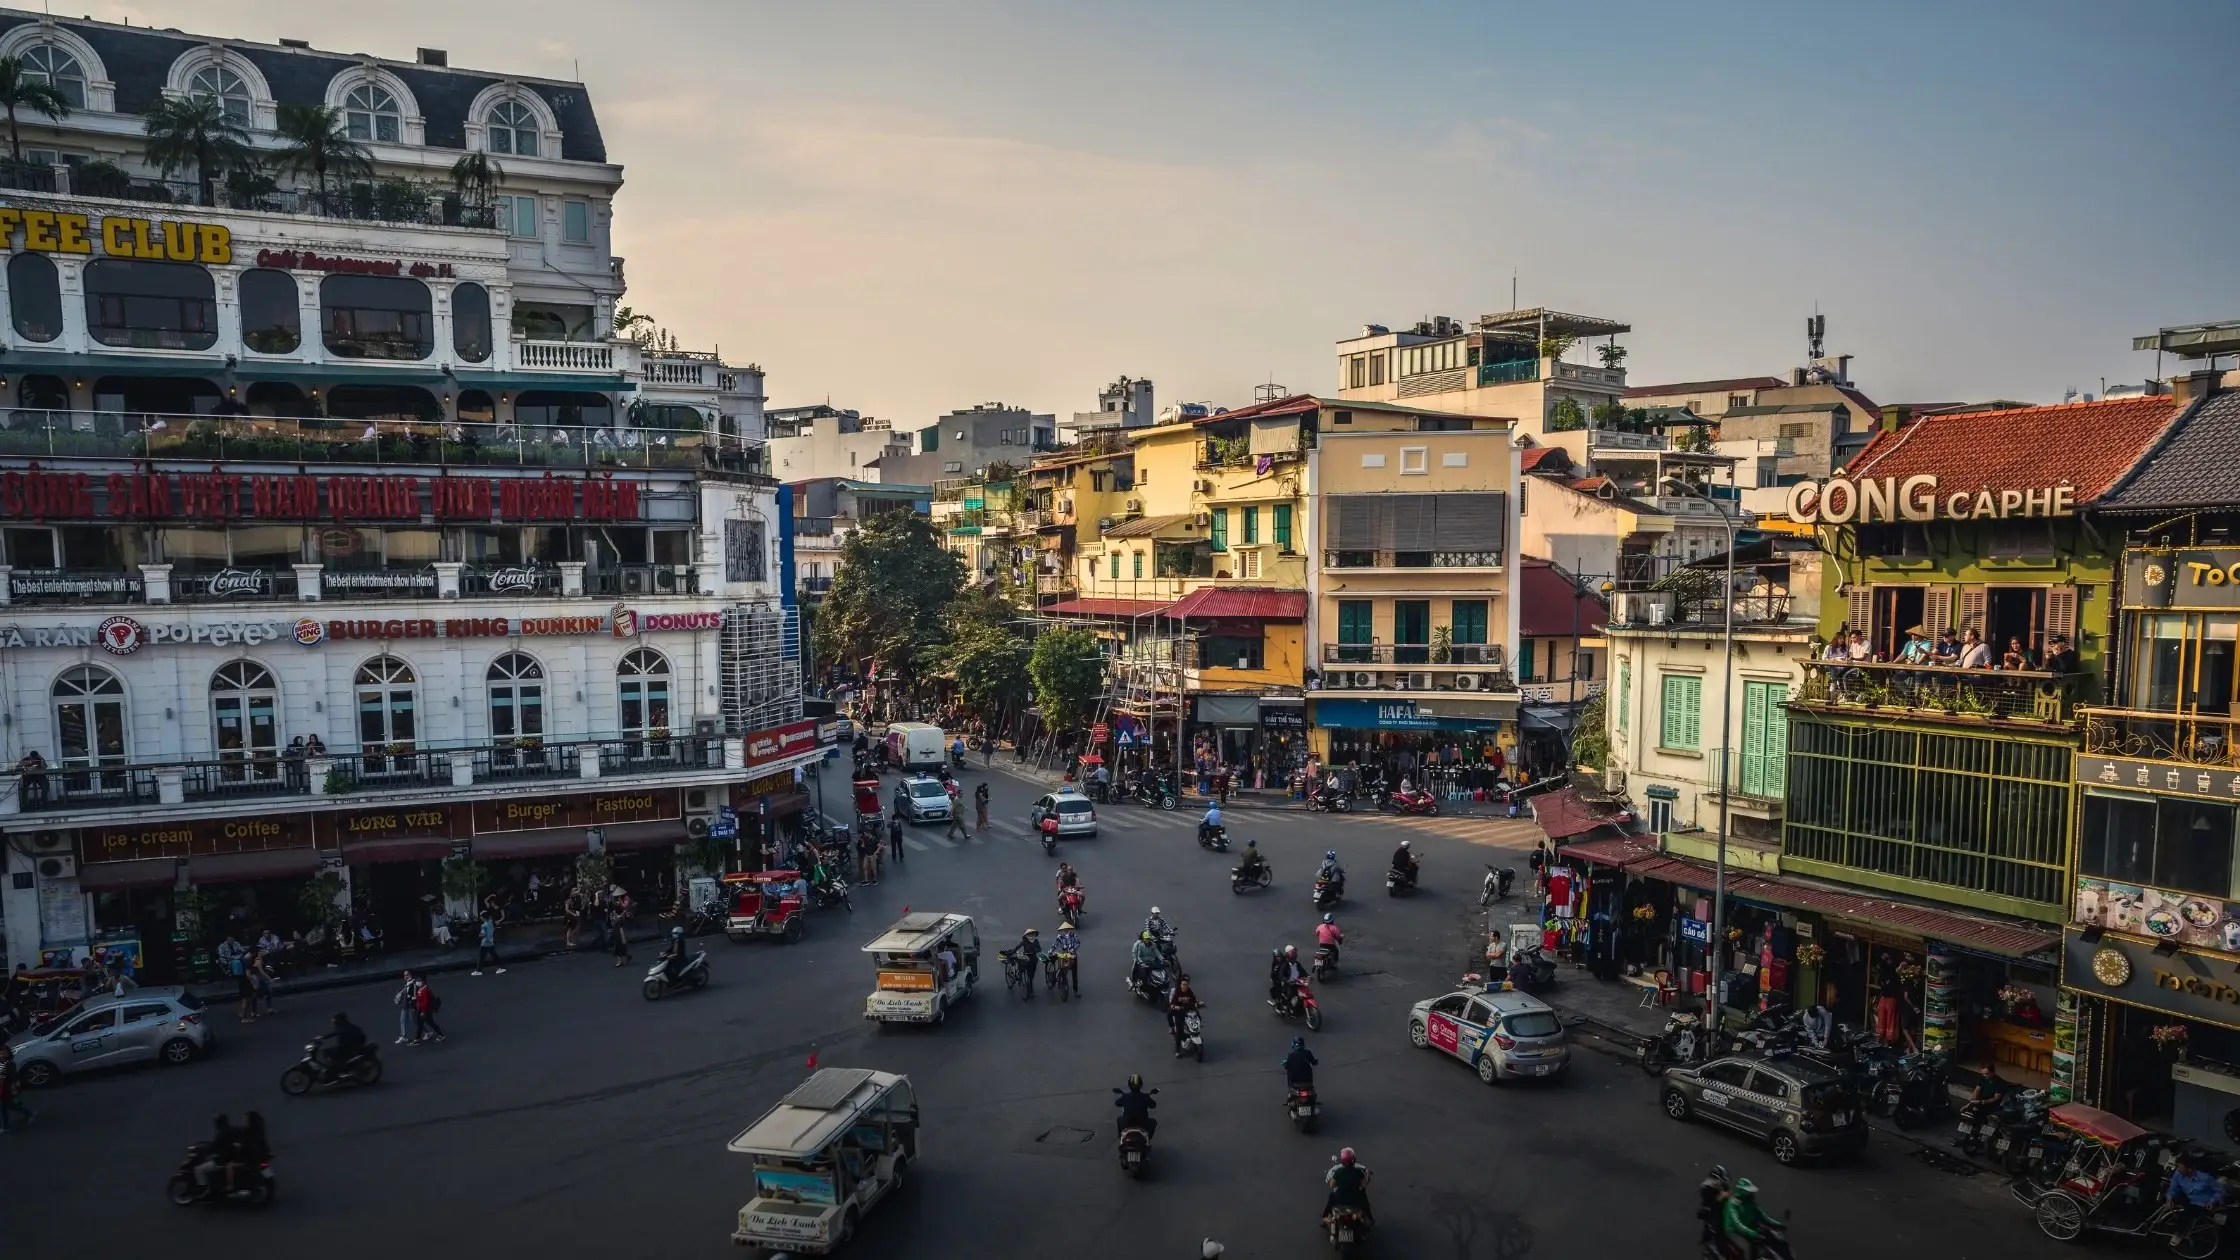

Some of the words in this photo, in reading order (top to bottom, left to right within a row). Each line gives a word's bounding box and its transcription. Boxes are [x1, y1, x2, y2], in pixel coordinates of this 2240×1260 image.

[102, 216, 232, 264] CLUB
[253, 475, 318, 518] NAM
[327, 475, 421, 521] QUANG
[12, 580, 27, 593] The
[27, 579, 43, 593] best
[44, 579, 94, 593] entertainment
[94, 578, 112, 592] show
[113, 579, 120, 592] in
[337, 575, 351, 587] best
[352, 575, 394, 587] entertainment
[394, 574, 410, 586] show
[417, 574, 434, 587] Hanoi
[99, 617, 141, 633] LOUISIANA
[295, 623, 320, 633] BURGER
[328, 619, 438, 640] BURGER
[445, 617, 510, 637] KING
[520, 616, 605, 635] DUNKIN'
[645, 612, 722, 631] DONUTS
[34, 622, 92, 647] RÁN
[296, 628, 320, 640] KING
[101, 641, 140, 655] KITCHEN
[508, 803, 557, 820] Burger
[596, 796, 653, 812] Fastfood
[224, 820, 281, 839] Coffee
[349, 813, 398, 832] LONG
